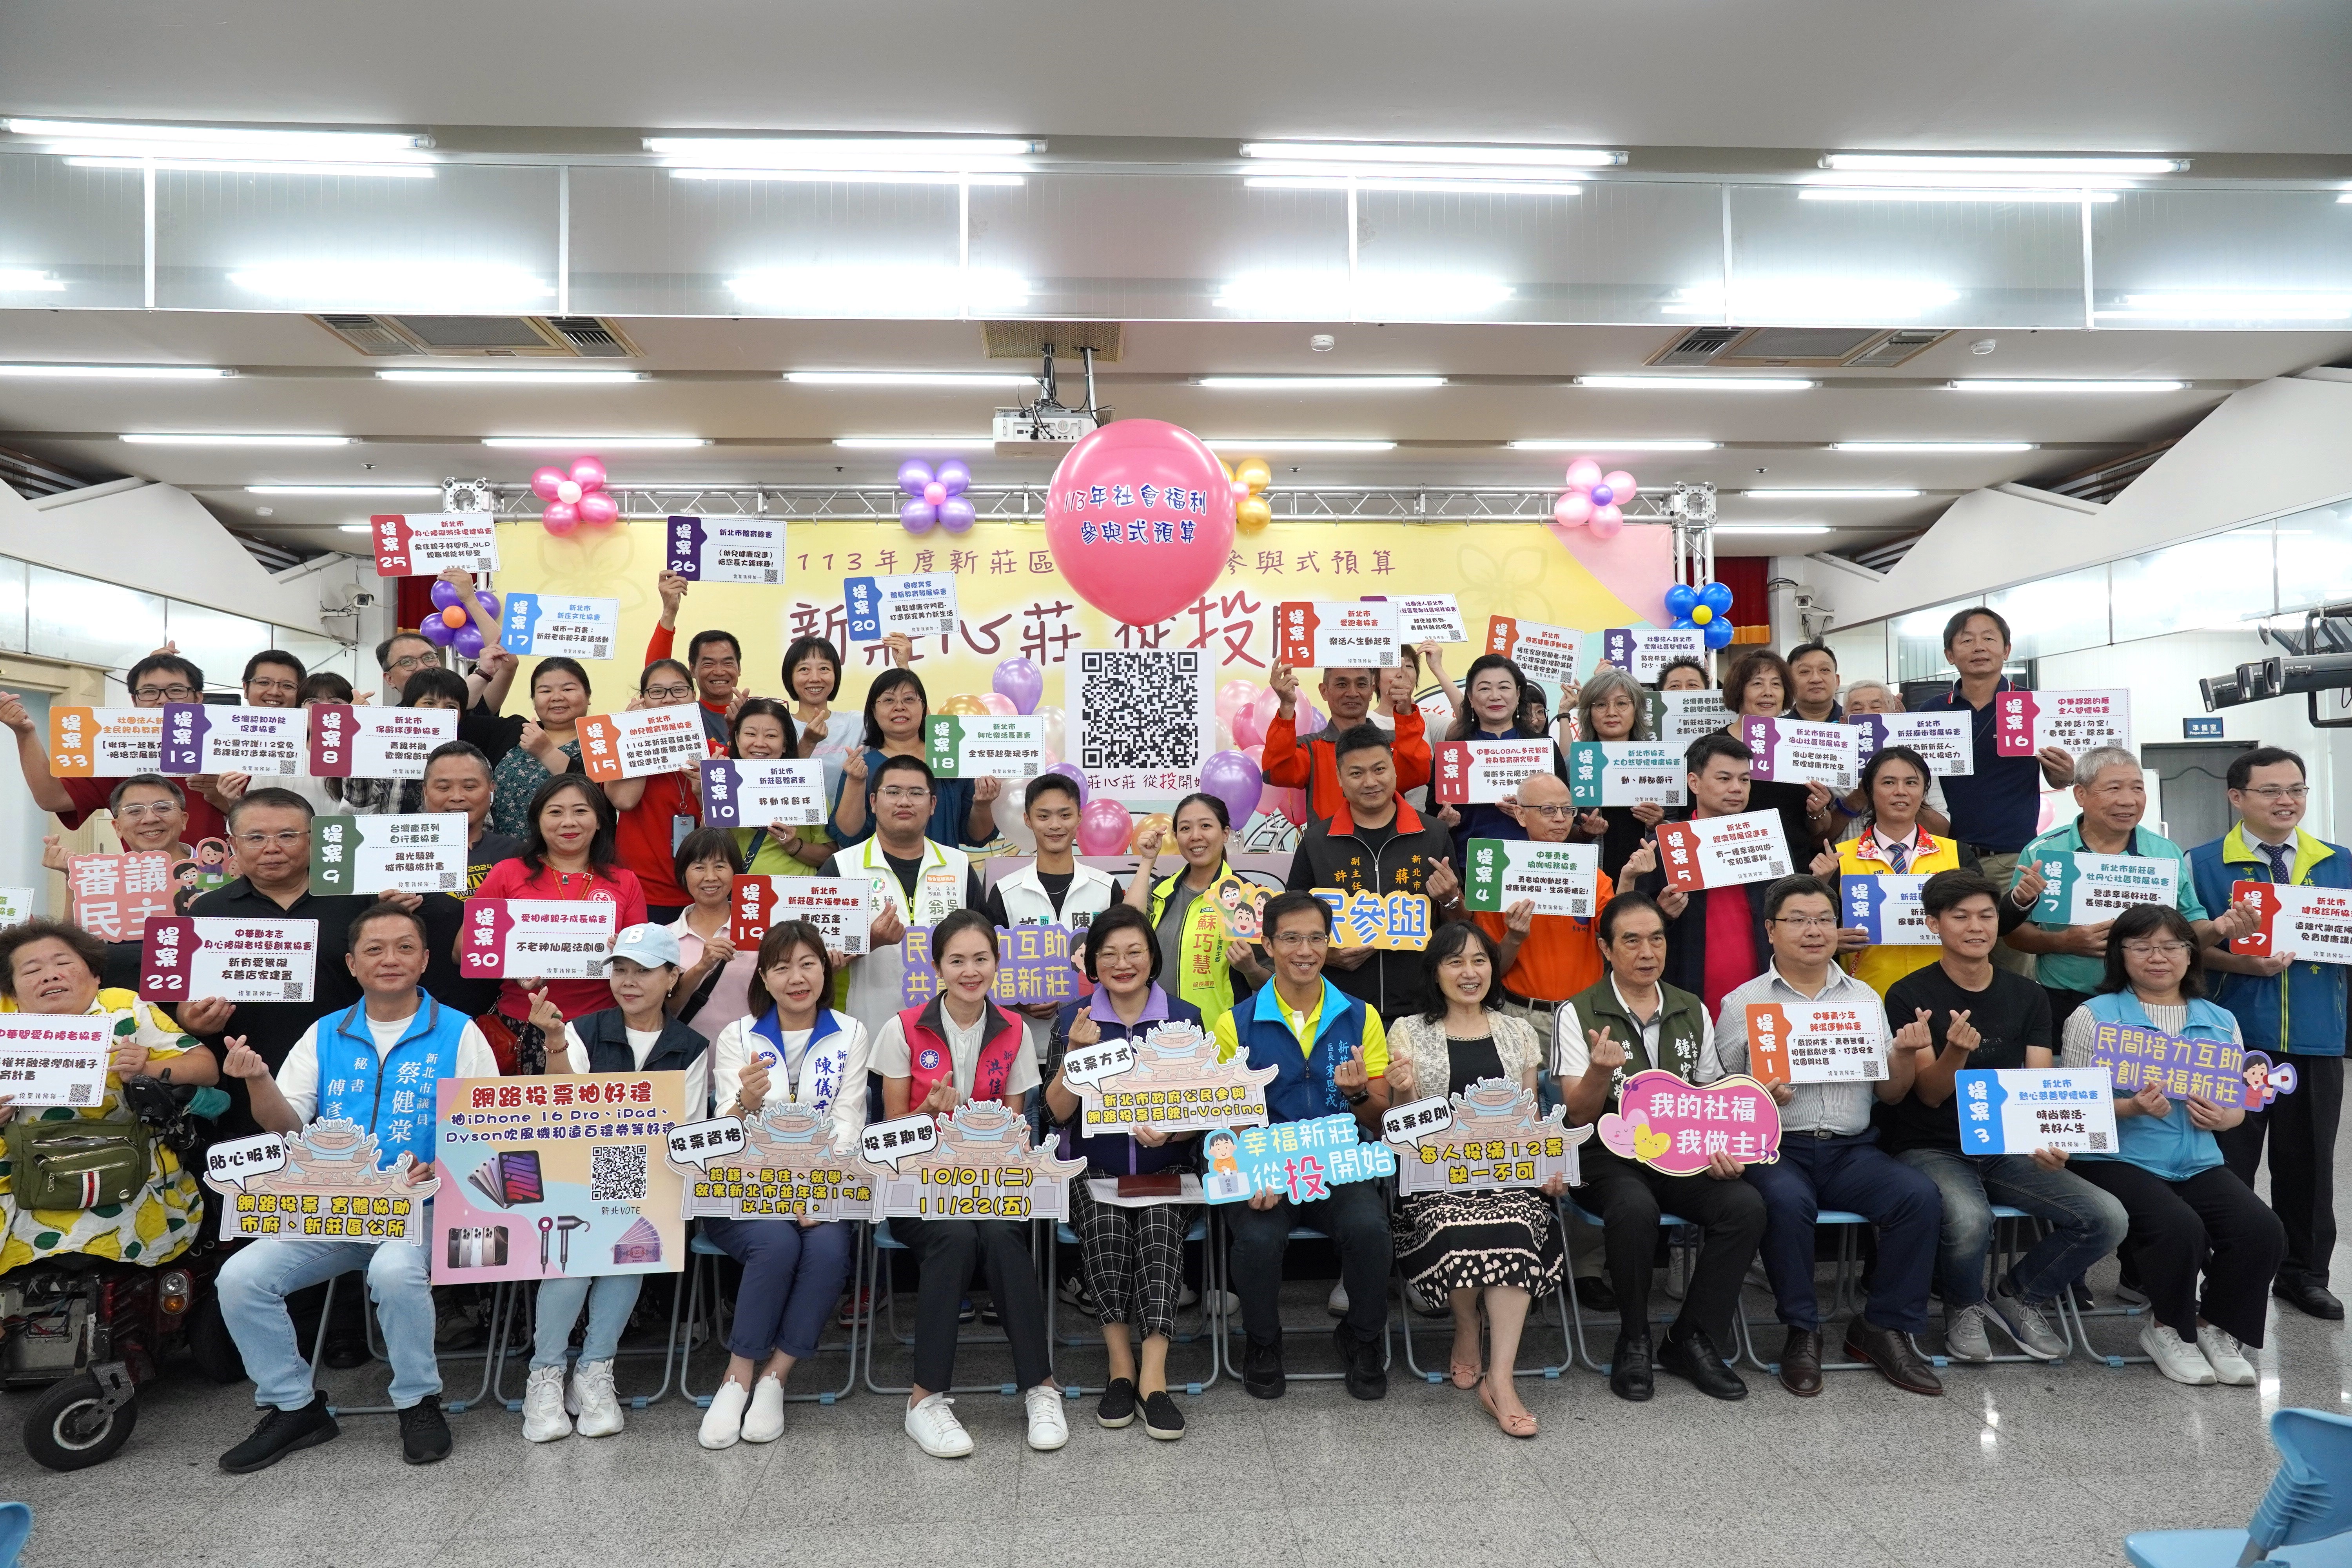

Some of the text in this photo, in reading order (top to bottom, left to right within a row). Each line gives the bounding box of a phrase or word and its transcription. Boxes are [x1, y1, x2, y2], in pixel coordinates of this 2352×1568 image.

[1064, 484, 1206, 515] 113年社會福利
[720, 529, 773, 538] 新北市體育總會
[1081, 520, 1197, 545] 參與式預算
[671, 524, 696, 572] 提案 26
[380, 557, 407, 568] 25
[852, 584, 876, 632] 提案 20
[508, 600, 529, 646] 提案 17
[1289, 609, 1309, 658] 提案 13
[537, 633, 609, 643] 新莊老街親子走讀活動
[1330, 637, 1391, 645] 樂活人生動起來
[1611, 635, 1624, 661] 提案
[232, 715, 285, 724] 台灣認知功能
[241, 724, 276, 733] 促進協會
[630, 721, 692, 735] 幼兒體育發展協會
[647, 715, 671, 724] 新北市
[2005, 699, 2029, 747] 提案 16
[56, 715, 88, 767] 提案 33
[170, 711, 196, 763] 提案 12
[321, 712, 341, 764] 提案 8
[376, 726, 440, 735] 保齡球運動協會
[1751, 724, 1766, 755] 提案
[1797, 728, 1840, 739] 新北市新莊區
[1898, 729, 1960, 737] 新莊廟街發展協會
[390, 742, 426, 750] 青銀共融
[587, 723, 617, 773] 提案 15
[933, 722, 954, 768] 提案 18
[1476, 746, 1548, 755] 中華GLOBAL多元智能
[1789, 737, 1848, 748] 海山社區發展協會
[969, 750, 1039, 758] 全家藝起來玩手作
[1443, 748, 1460, 795] 提案 11
[1574, 749, 1594, 797] 提案 21
[710, 768, 735, 818] 提案 10
[759, 797, 810, 806] 移動保齡球
[1713, 829, 1768, 844] 經濟發展促進會
[1726, 822, 1750, 832] 新北市
[390, 834, 439, 844] 自行車協會
[321, 824, 343, 883] 提案 9
[1536, 851, 1569, 860] 中華勇者
[1668, 831, 1691, 882] 提案 5
[385, 862, 445, 872] 城市騎旅計畫
[1350, 857, 1362, 891] 副主任
[1475, 848, 1493, 902] 提案 4
[1528, 861, 1577, 871] 瑜伽服務協會
[2101, 864, 2156, 875] 新北市新莊區
[75, 857, 168, 897] 審議
[2087, 873, 2169, 886] 牡丹心社區發展協會
[811, 887, 837, 895] 新北市
[1851, 884, 1870, 917] 提案
[2317, 897, 2346, 906] 新北市
[742, 884, 760, 920] 提案
[788, 897, 859, 907] 新莊區太極拳協會
[2044, 899, 2058, 912] 7
[80, 898, 167, 940] 民主
[521, 914, 607, 924] 愛相隨親子成長協會
[204, 940, 312, 950] 身心障礙者技藝創業協會
[467, 908, 499, 967] 提案 30
[625, 927, 644, 944] B
[1192, 915, 1217, 975] 蘇巧慧
[146, 927, 182, 989] 提案 22
[516, 942, 605, 953] 不老神仙魔法劇團
[222, 970, 292, 980] 友善店家建置
[1813, 1011, 1856, 1020] 中華青少年
[1757, 1014, 1777, 1053] 提案
[1810, 1022, 1862, 1032] 純潔運動協會
[2097, 1026, 2243, 1072] 民間培力互助
[1067, 1049, 1131, 1073] 投票方式
[1793, 1057, 1829, 1066] 校園與社區
[354, 1057, 368, 1092] 秘書
[2042, 1079, 2073, 1089] 新北市
[416, 1053, 438, 1125] 新北市議員
[472, 1081, 652, 1109] 網路投票抽好禮
[1103, 1087, 1246, 1107] 新北市政府公民參與
[2019, 1090, 2098, 1100] 熱心慈善關懷協會
[386, 1062, 421, 1143] 蔡健棠
[1087, 1103, 1264, 1123] 網路投票系統i-Voting
[1650, 1091, 1757, 1123] 我的社福
[1968, 1081, 1990, 1143] 提案 3
[452, 1112, 531, 1125] 抽iPhone
[542, 1111, 562, 1122] 16
[1386, 1104, 1448, 1133] 投票規則
[2040, 1122, 2085, 1134] 美好人生
[446, 1122, 675, 1143] Dyson吹風機和遠百禮券等好禮
[671, 1129, 742, 1152] 投票資格
[863, 1123, 933, 1152] 投票期間
[1244, 1119, 1358, 1158] 幸福新莊
[1419, 1137, 1564, 1163] 每人投滿12票
[1677, 1129, 1768, 1158] 我做主!
[209, 1143, 282, 1171] 貼心服務
[709, 1167, 856, 1183] 設籍、居住、就學、
[920, 1167, 1033, 1187] 10/01(二)
[1253, 1149, 1392, 1201] 從投開始
[1449, 1161, 1534, 1184] 缺一不可
[238, 1195, 410, 1216] 網路投票 實體協助
[602, 1207, 640, 1215] 新北VOTE
[920, 1196, 1031, 1216] 11/22(五)
[241, 1217, 405, 1238] 市府、新莊區公所
